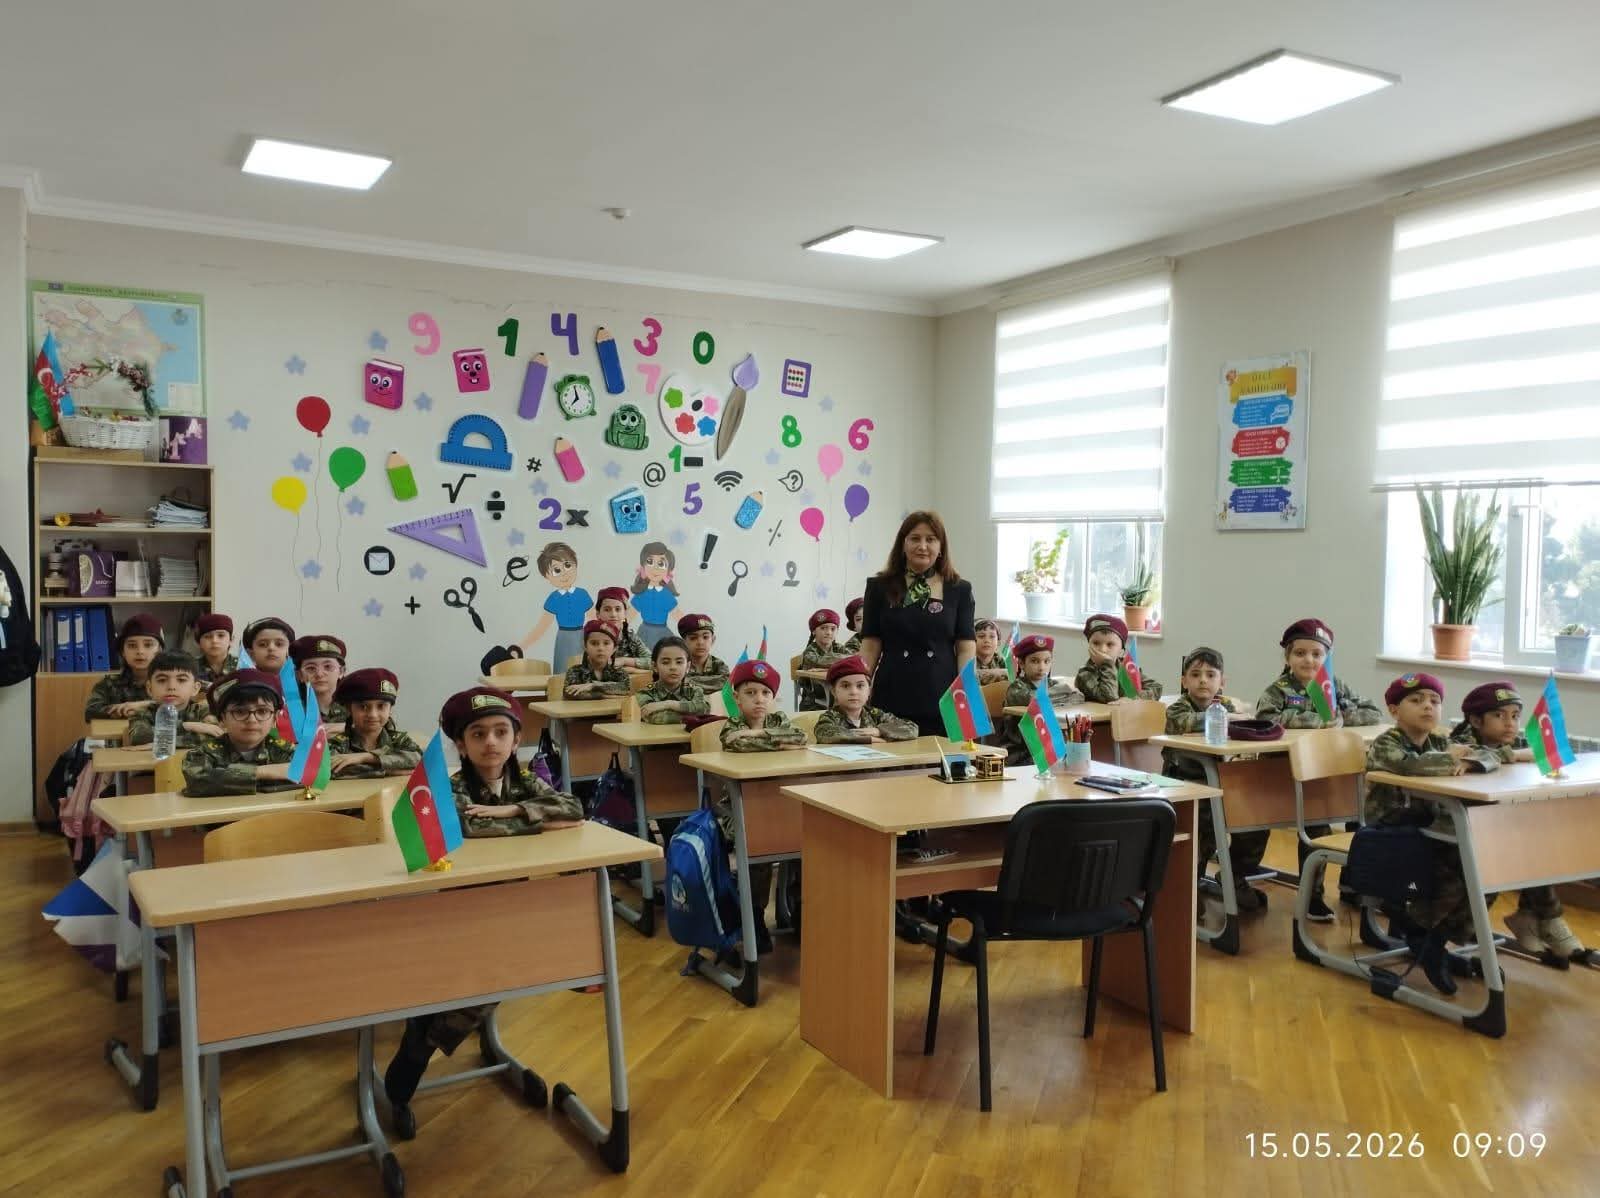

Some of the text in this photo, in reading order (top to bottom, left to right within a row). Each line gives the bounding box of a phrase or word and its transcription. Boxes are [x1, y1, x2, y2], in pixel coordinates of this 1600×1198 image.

[409, 313, 440, 355] 9
[498, 318, 519, 357] 1
[551, 313, 579, 356] 4
[633, 318, 662, 356] 3
[638, 364, 660, 393] 7
[781, 415, 802, 448] 8
[848, 418, 874, 450] 6
[526, 457, 542, 472] #
[643, 462, 666, 487] @
[668, 445, 682, 472] 1
[683, 482, 703, 515] 5
[791, 475, 798, 490] ?
[538, 498, 563, 531] 2
[699, 533, 718, 570] !
